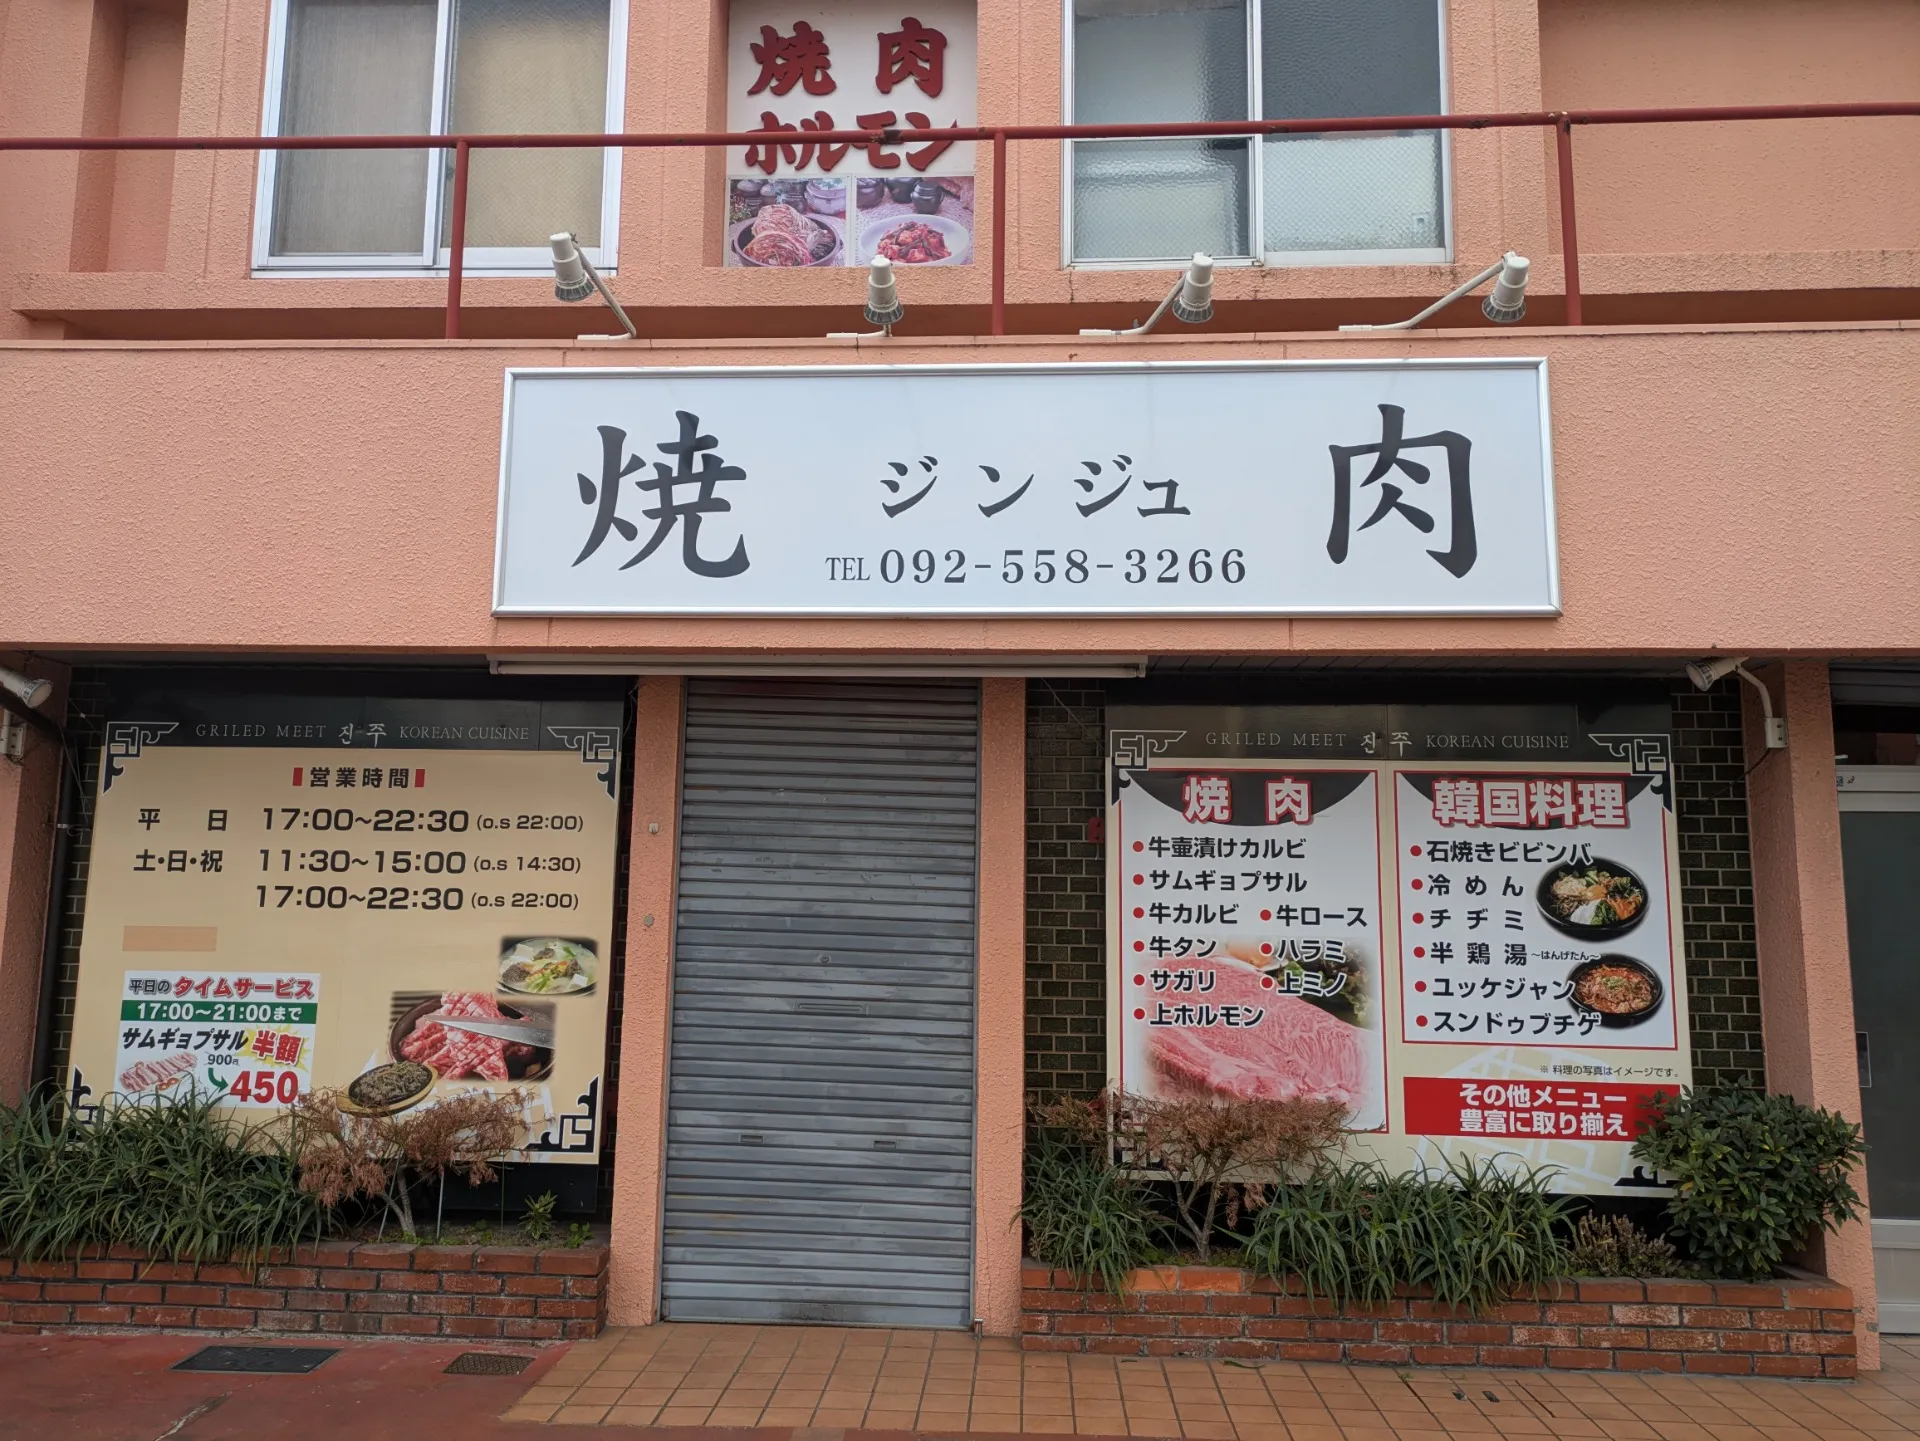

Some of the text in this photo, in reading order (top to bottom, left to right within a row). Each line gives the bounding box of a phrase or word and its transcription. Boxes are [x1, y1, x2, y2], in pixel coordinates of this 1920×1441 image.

[744, 110, 958, 175] ホルモン
[880, 454, 1191, 518] ジンジュ
[825, 548, 1246, 584] TEL 092-558-3266
[196, 724, 327, 739] GRILED MEET
[400, 726, 529, 741] KOREAN CUISINE
[1205, 732, 1347, 747] GRILED MEET
[1426, 734, 1569, 749] KOREAN CUISINE
[310, 766, 409, 789] 営業時間
[1433, 779, 1628, 827] 韓国料理
[1426, 840, 1593, 865] 石焼きビビンバ
[1149, 869, 1308, 893] サムギョプサル
[1149, 903, 1240, 925] 牛カルビ
[1276, 904, 1368, 928] 牛ロース
[1149, 935, 1218, 959] 牛タン
[1276, 939, 1347, 962] ハラミ
[1149, 969, 1217, 993] サガリ
[1276, 971, 1347, 997] 上ミノ
[1432, 976, 1575, 1001] ユッケジャン
[1149, 1002, 1265, 1028] 上ホルモン
[1433, 1010, 1602, 1037] スンドゥブチゲ
[122, 1027, 249, 1051] サムギョプサル
[251, 1030, 303, 1064] 半額
[229, 1070, 300, 1104] 450
[1459, 1083, 1627, 1109] その他メニュー
[1459, 1108, 1629, 1137] 豊富に取り揃え
